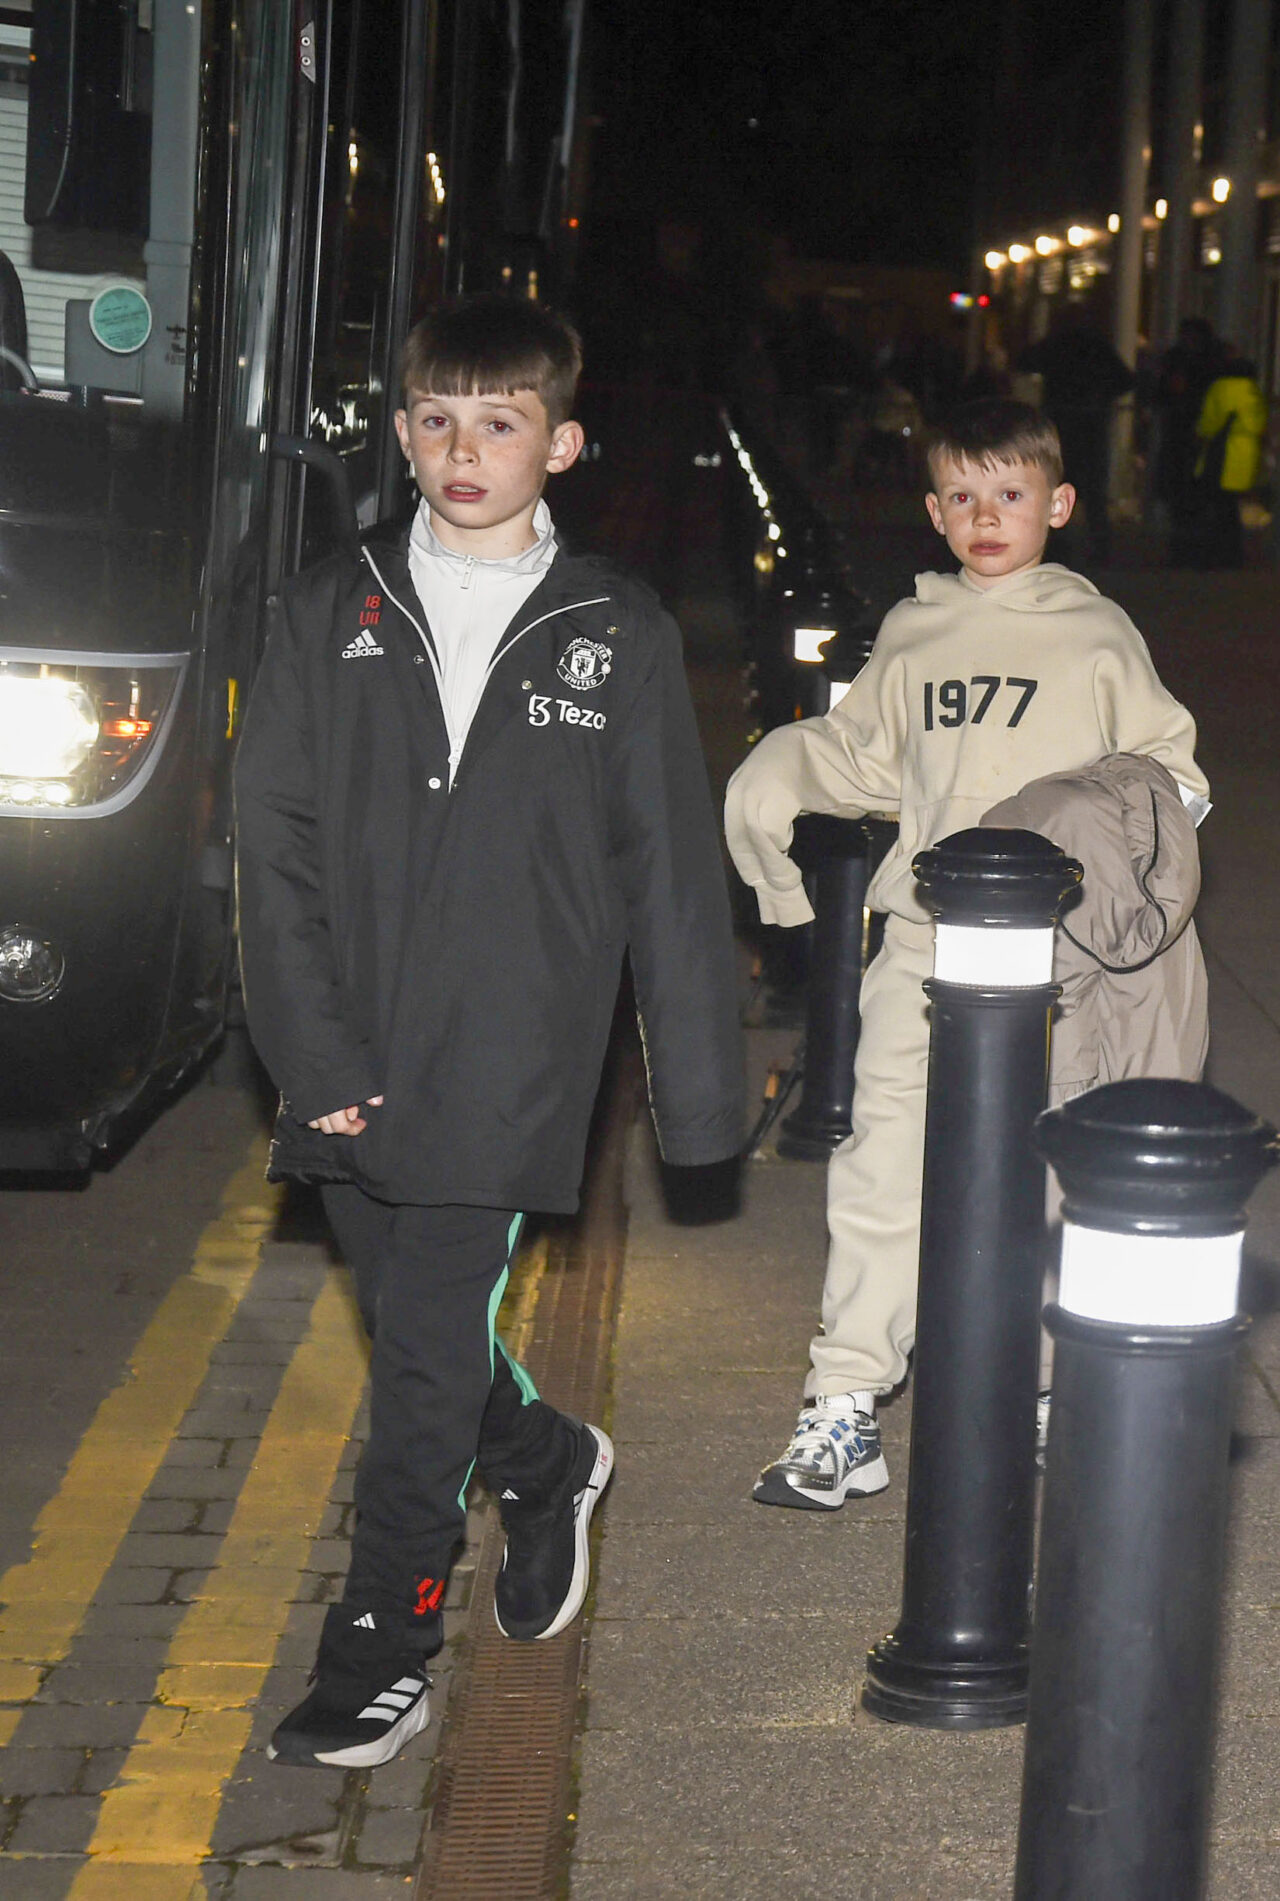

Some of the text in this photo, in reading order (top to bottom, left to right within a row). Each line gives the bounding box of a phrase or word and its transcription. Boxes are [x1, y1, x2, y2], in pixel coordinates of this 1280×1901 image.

[365, 595, 381, 609] 18
[341, 647, 384, 659] adidas
[566, 637, 608, 660] ANCHESTER
[564, 673, 597, 687] UNITED
[924, 675, 1038, 731] 1977
